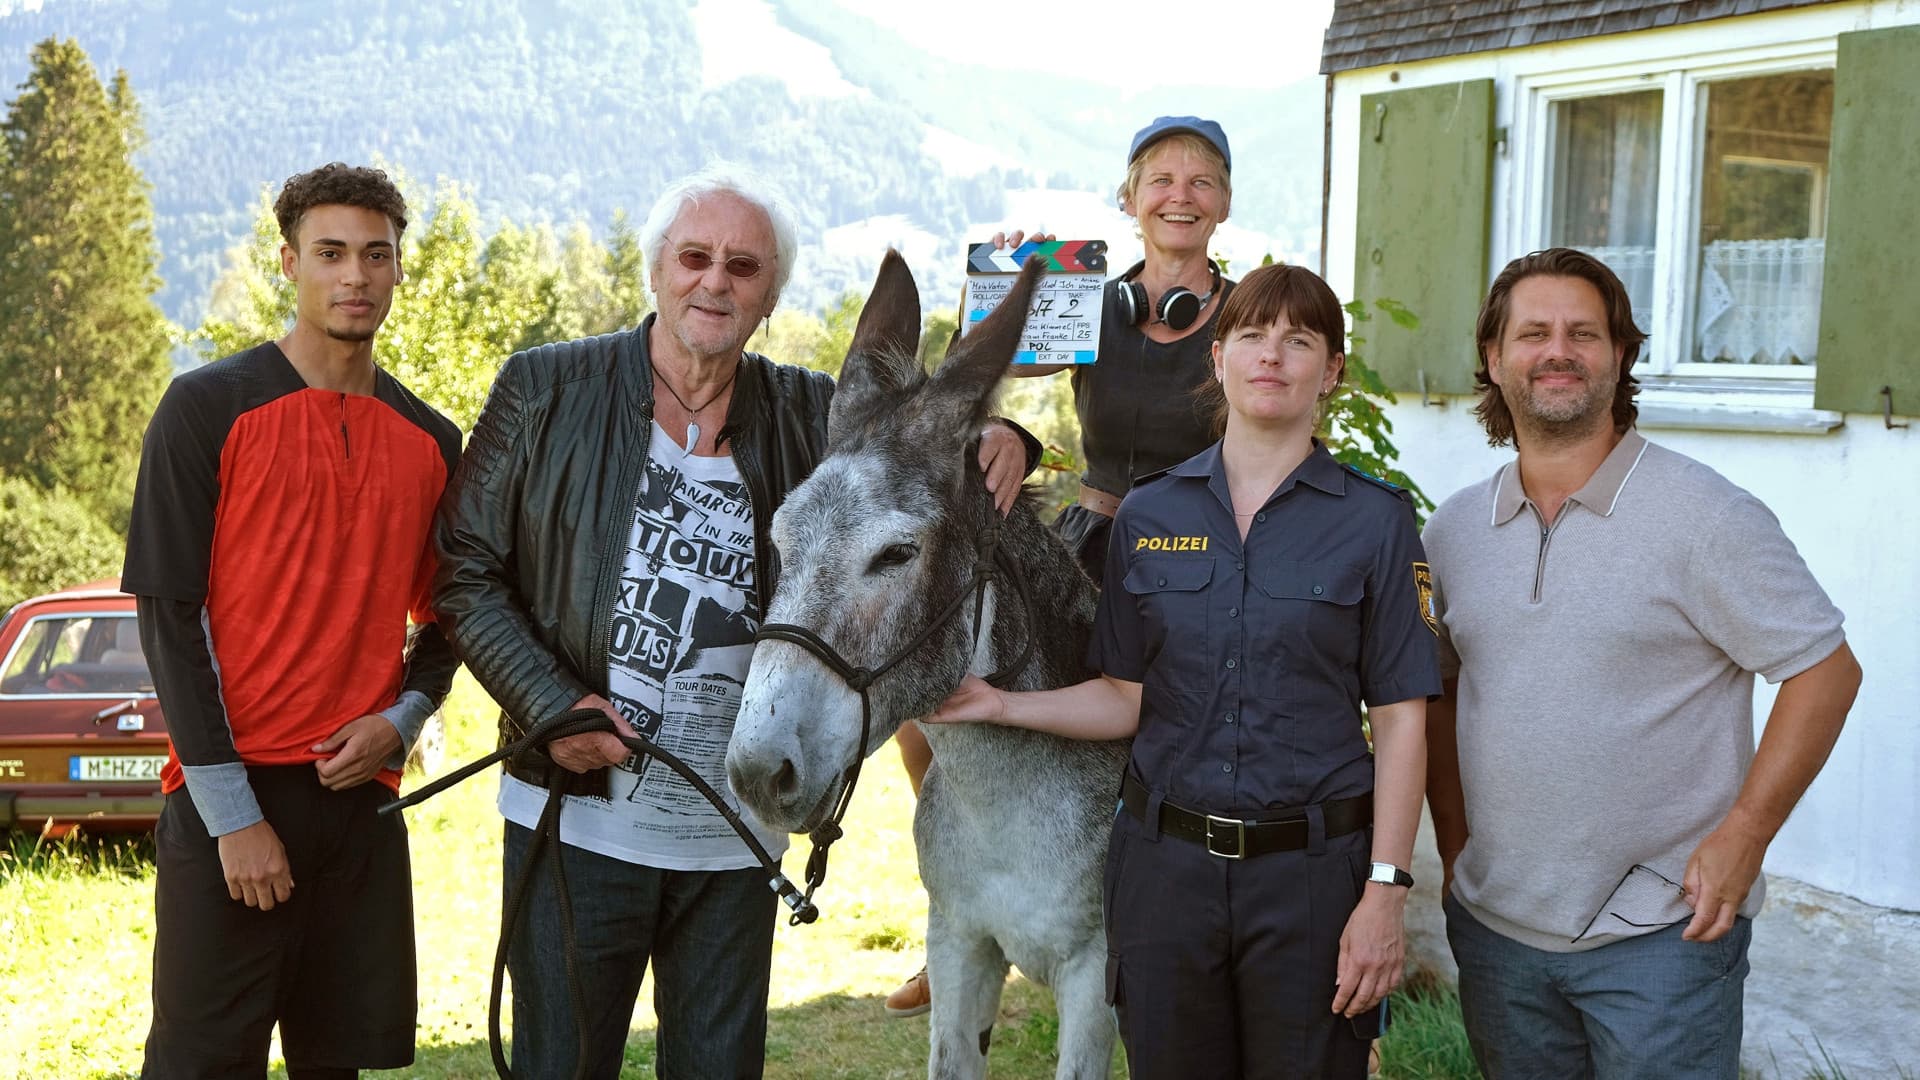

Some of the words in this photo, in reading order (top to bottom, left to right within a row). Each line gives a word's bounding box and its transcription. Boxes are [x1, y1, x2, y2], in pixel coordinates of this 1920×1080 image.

[1058, 299, 1083, 318] 2
[1077, 330, 1092, 339] 25
[676, 482, 753, 523] ANARCHY
[704, 524, 721, 539] IN
[727, 531, 754, 548] THE
[1136, 537, 1208, 551] POLIZEI
[675, 681, 698, 692] TOUR
[701, 683, 727, 696] DATES
[88, 760, 101, 776] M
[112, 760, 137, 776] HZ
